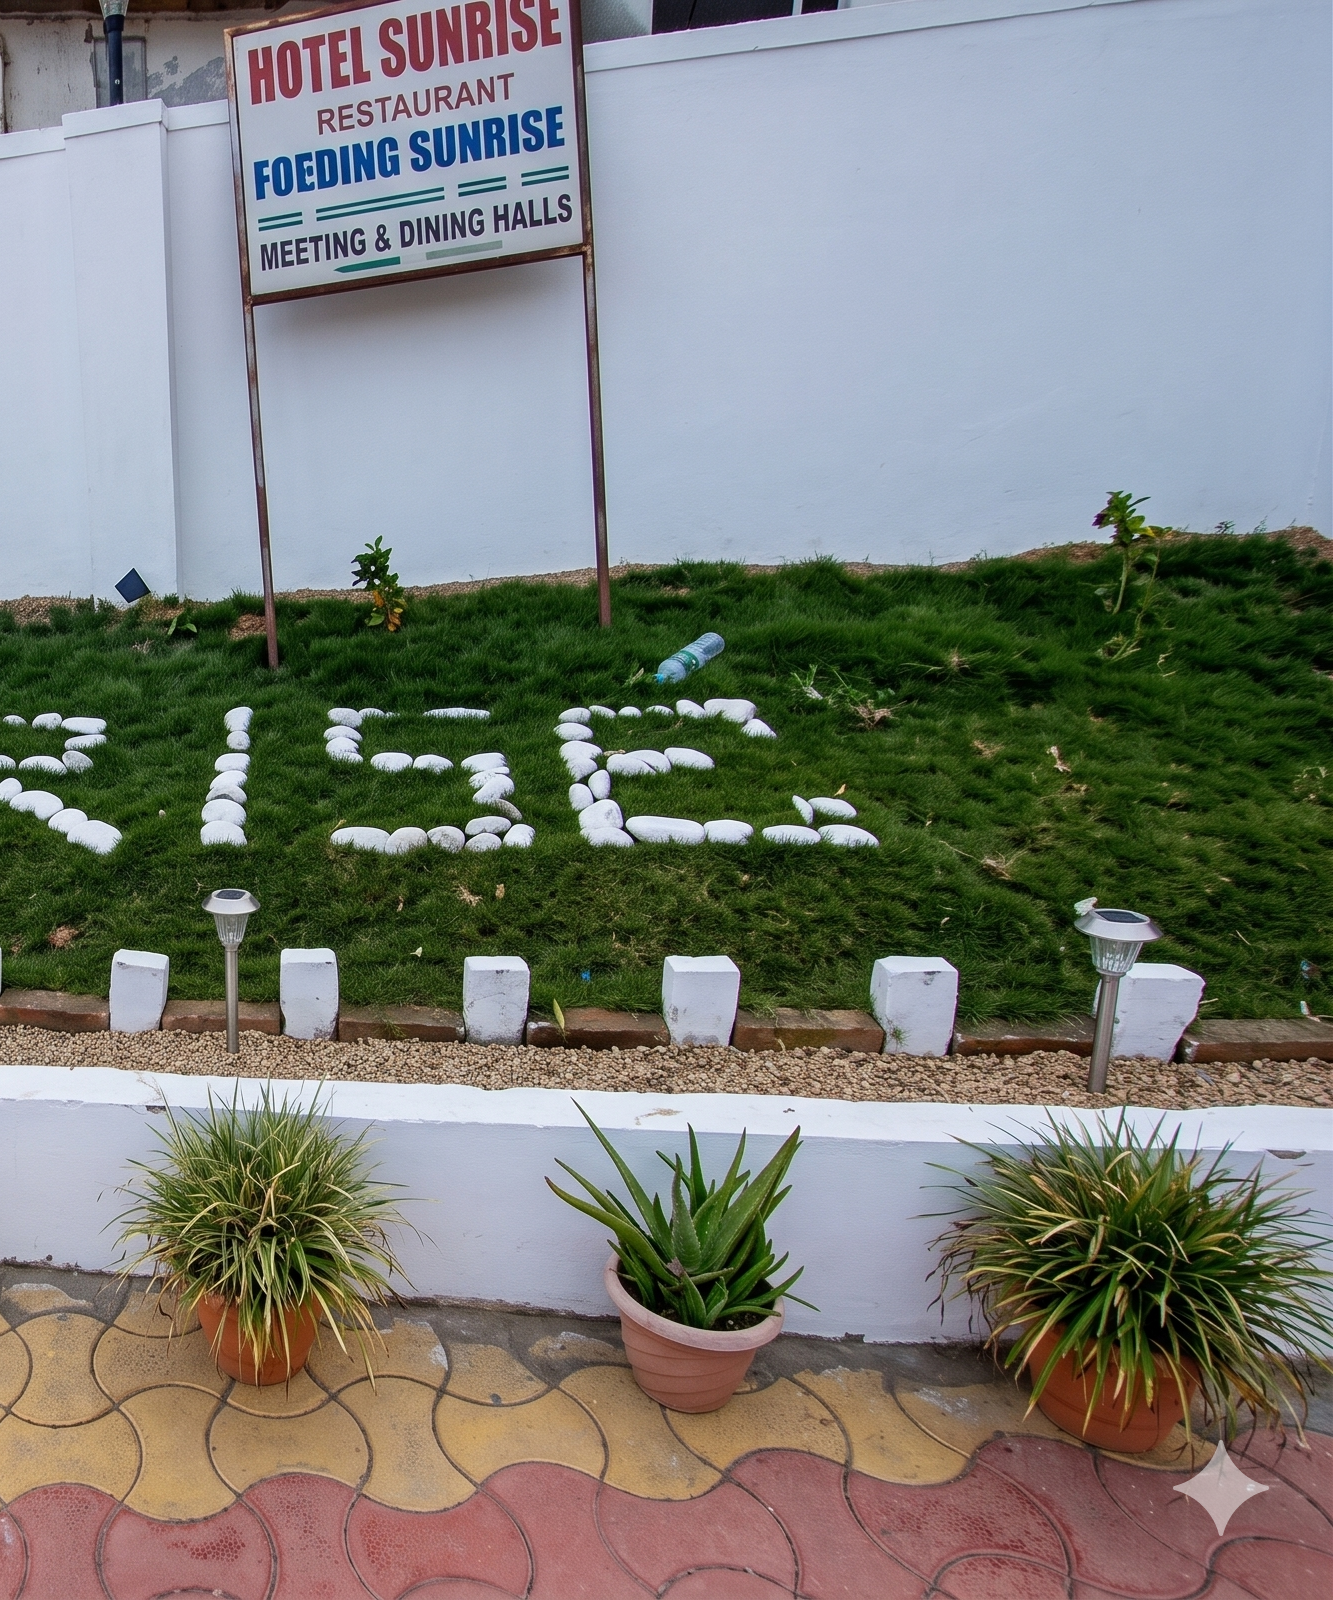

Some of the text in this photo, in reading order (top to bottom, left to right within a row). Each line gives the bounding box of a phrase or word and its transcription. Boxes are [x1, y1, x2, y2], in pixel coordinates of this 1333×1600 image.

[247, 0, 562, 106] HOTEL SUNRISE
[317, 72, 515, 135] RESTAURANT
[408, 105, 565, 172] SUNRISE
[259, 193, 573, 271] MEETING & DINING HALLS
